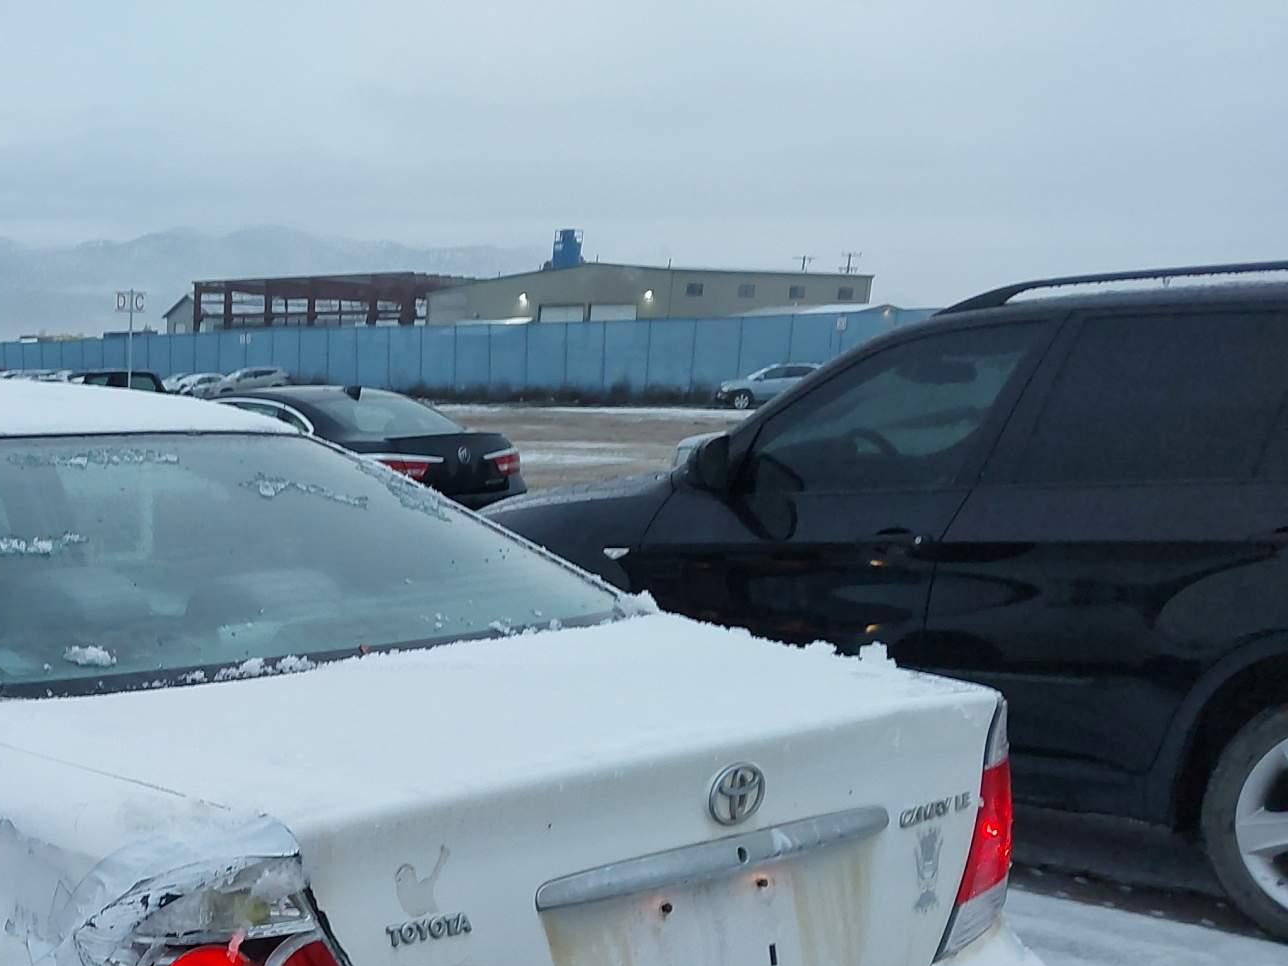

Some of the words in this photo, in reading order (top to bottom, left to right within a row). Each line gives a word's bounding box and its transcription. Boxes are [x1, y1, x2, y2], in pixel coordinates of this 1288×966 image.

[117, 292, 126, 310] D
[135, 293, 145, 311] C
[385, 912, 472, 948] TOYOTA
